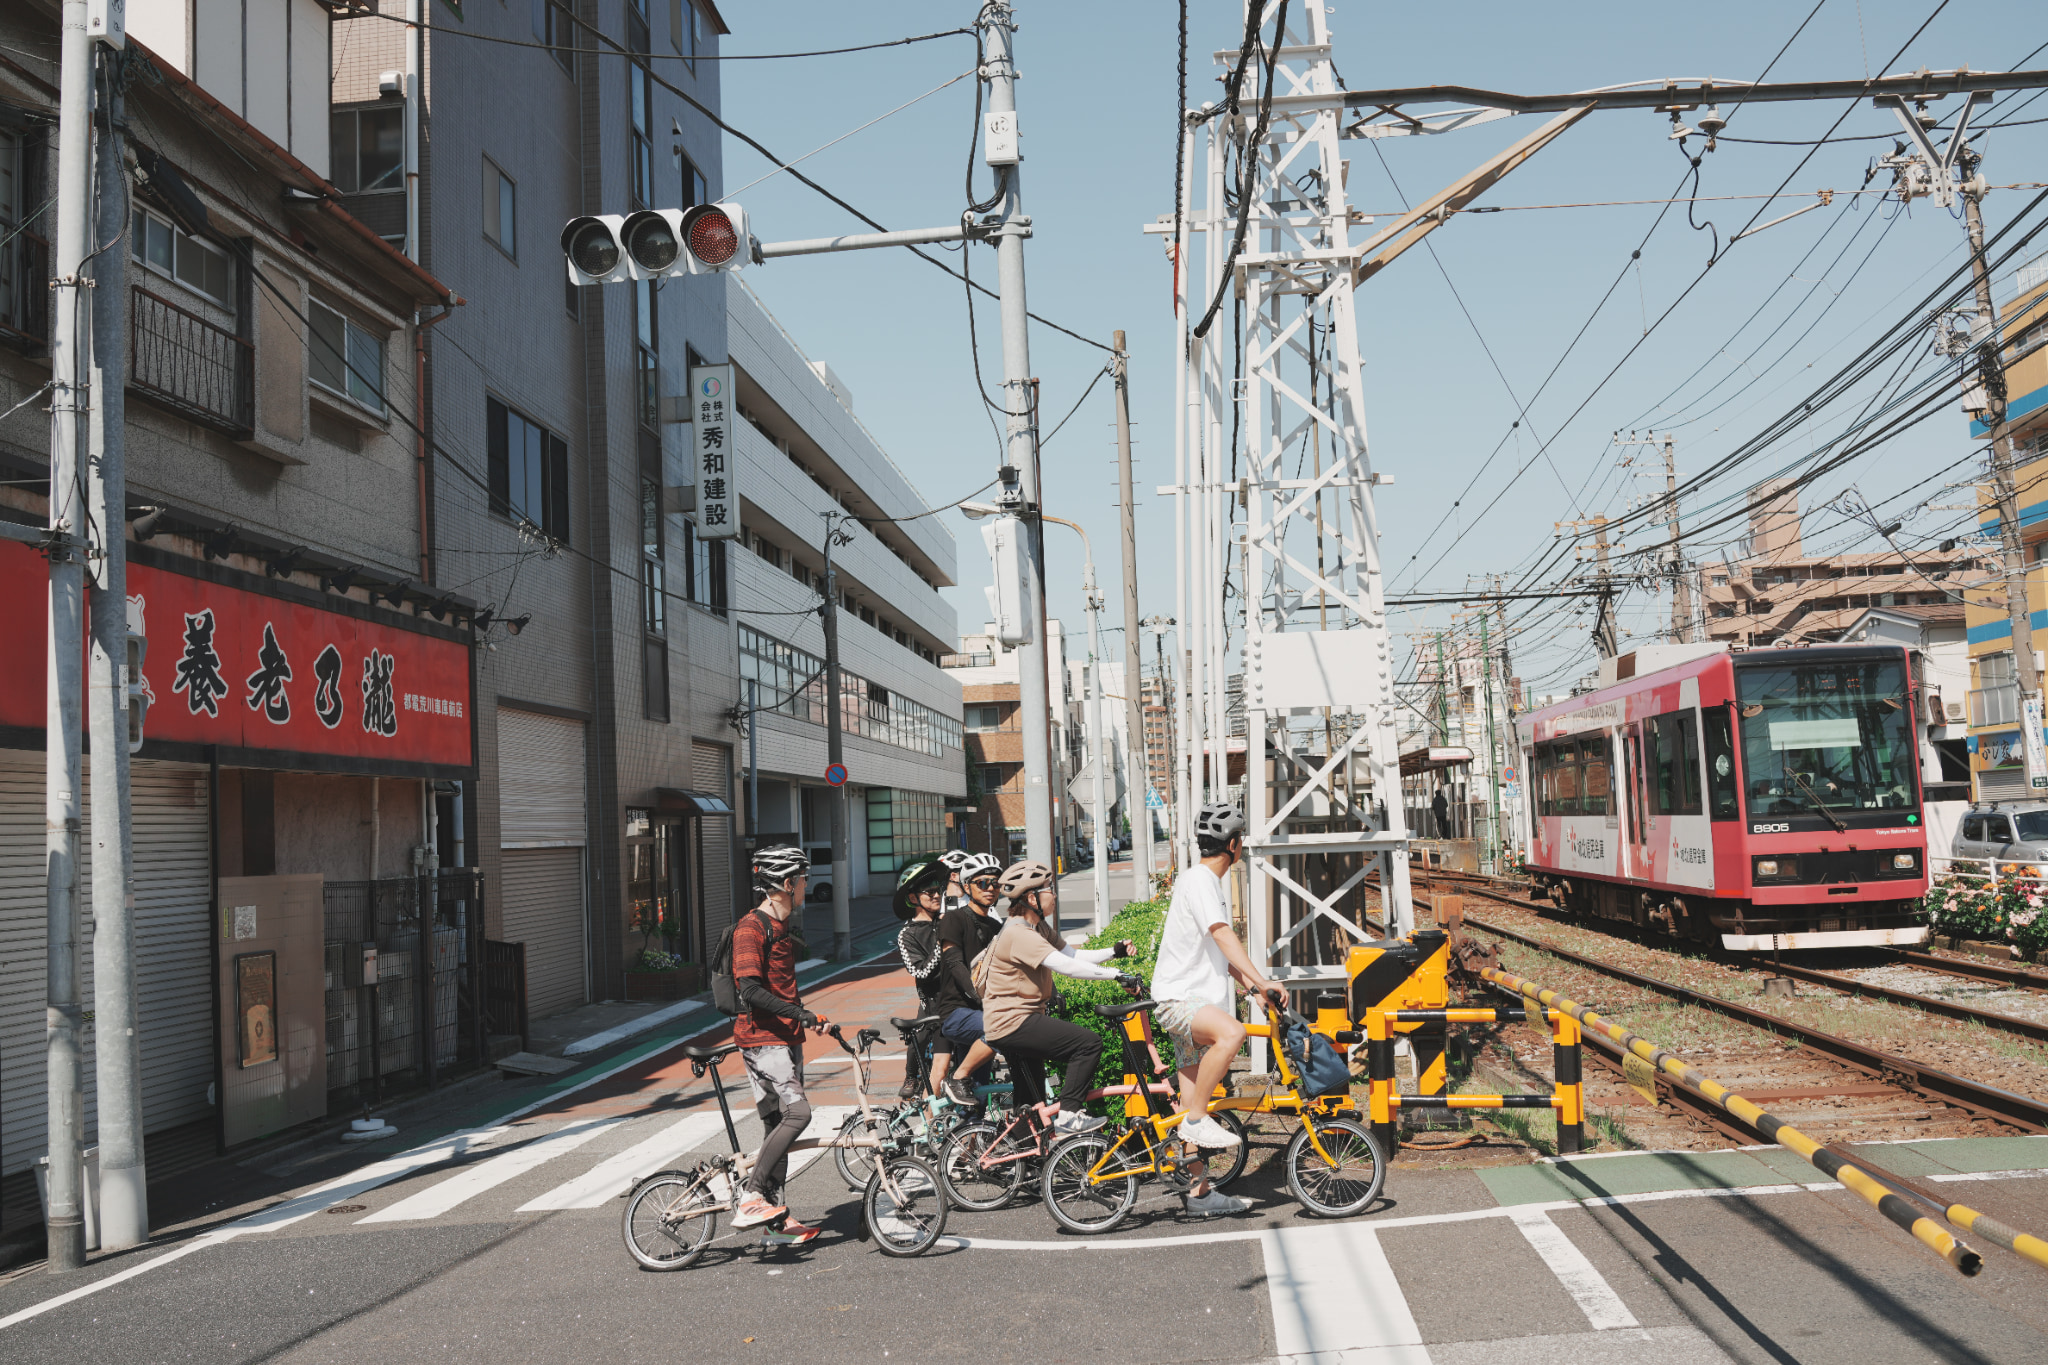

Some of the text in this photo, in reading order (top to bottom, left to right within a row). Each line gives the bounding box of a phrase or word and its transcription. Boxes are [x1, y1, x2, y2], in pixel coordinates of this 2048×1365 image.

[702, 427, 728, 526] 秀和建設
[172, 608, 397, 737] 養老乃瀧
